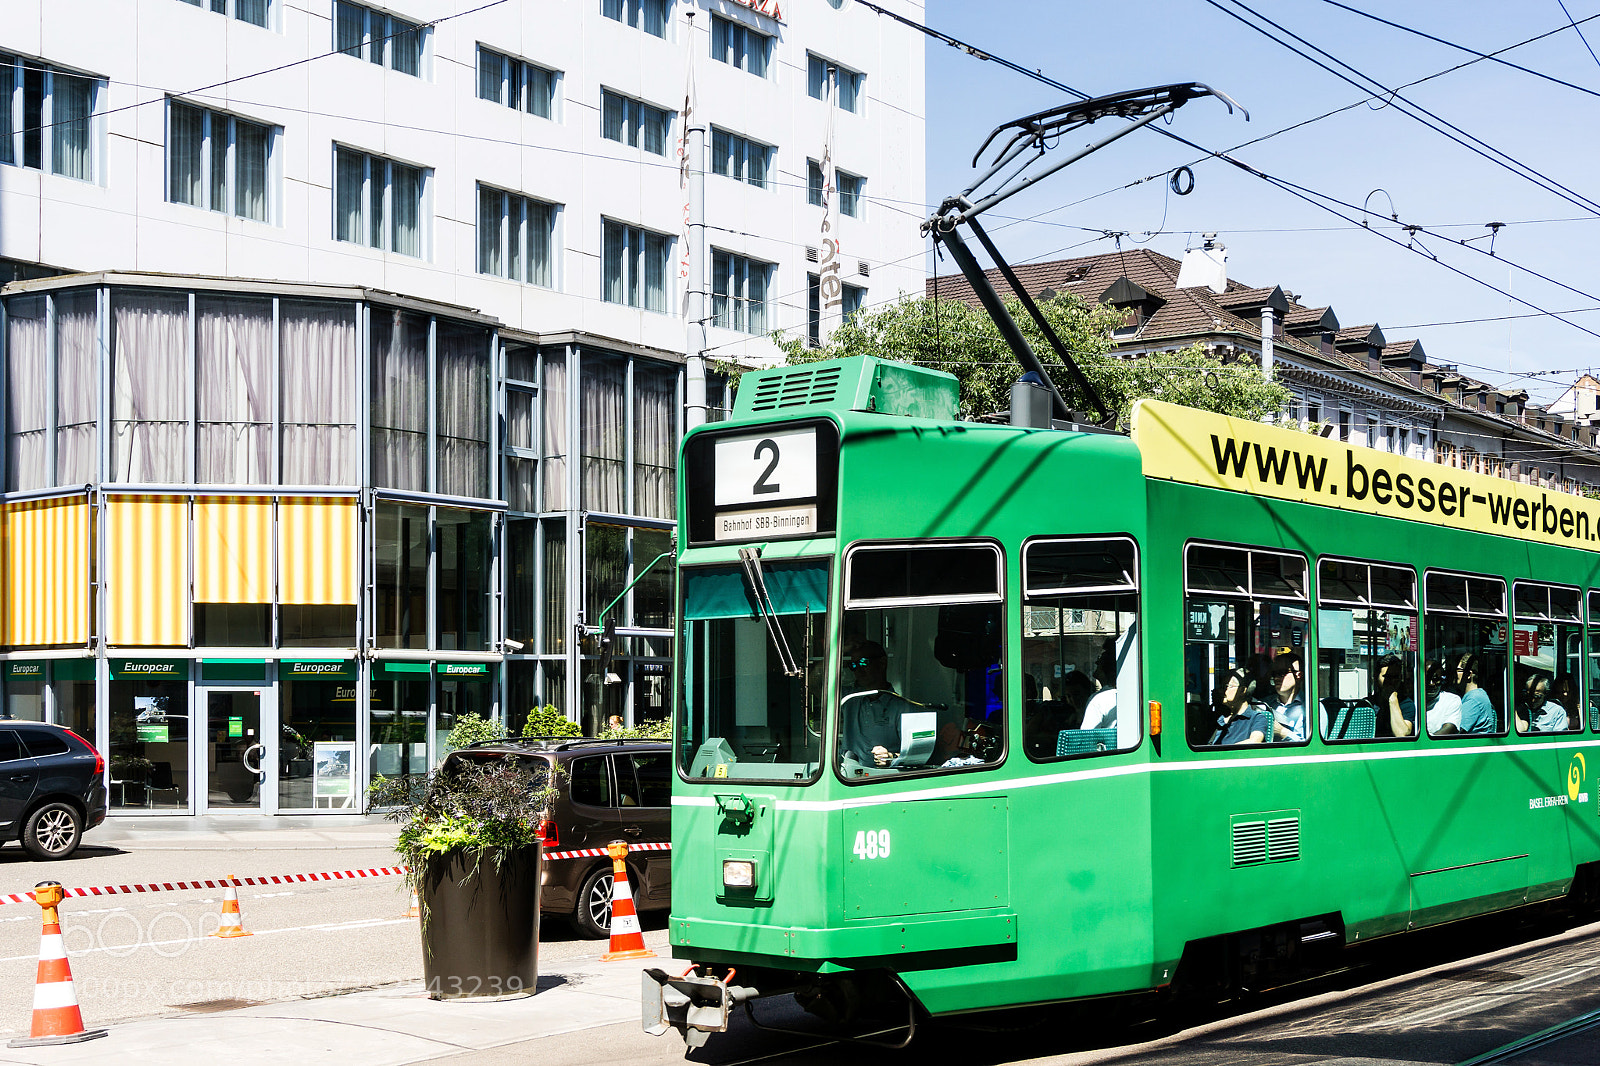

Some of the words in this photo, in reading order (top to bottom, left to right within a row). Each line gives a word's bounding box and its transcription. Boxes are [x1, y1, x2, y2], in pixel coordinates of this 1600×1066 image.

[752, 438, 780, 495] 2
[723, 518, 752, 532] Bahnhof
[12, 664, 39, 675] Europcar
[124, 662, 174, 674] Europcar
[293, 662, 342, 674] Europcar
[446, 664, 481, 676] Europcar
[1529, 797, 1545, 809] BASEL
[853, 829, 891, 860] 489
